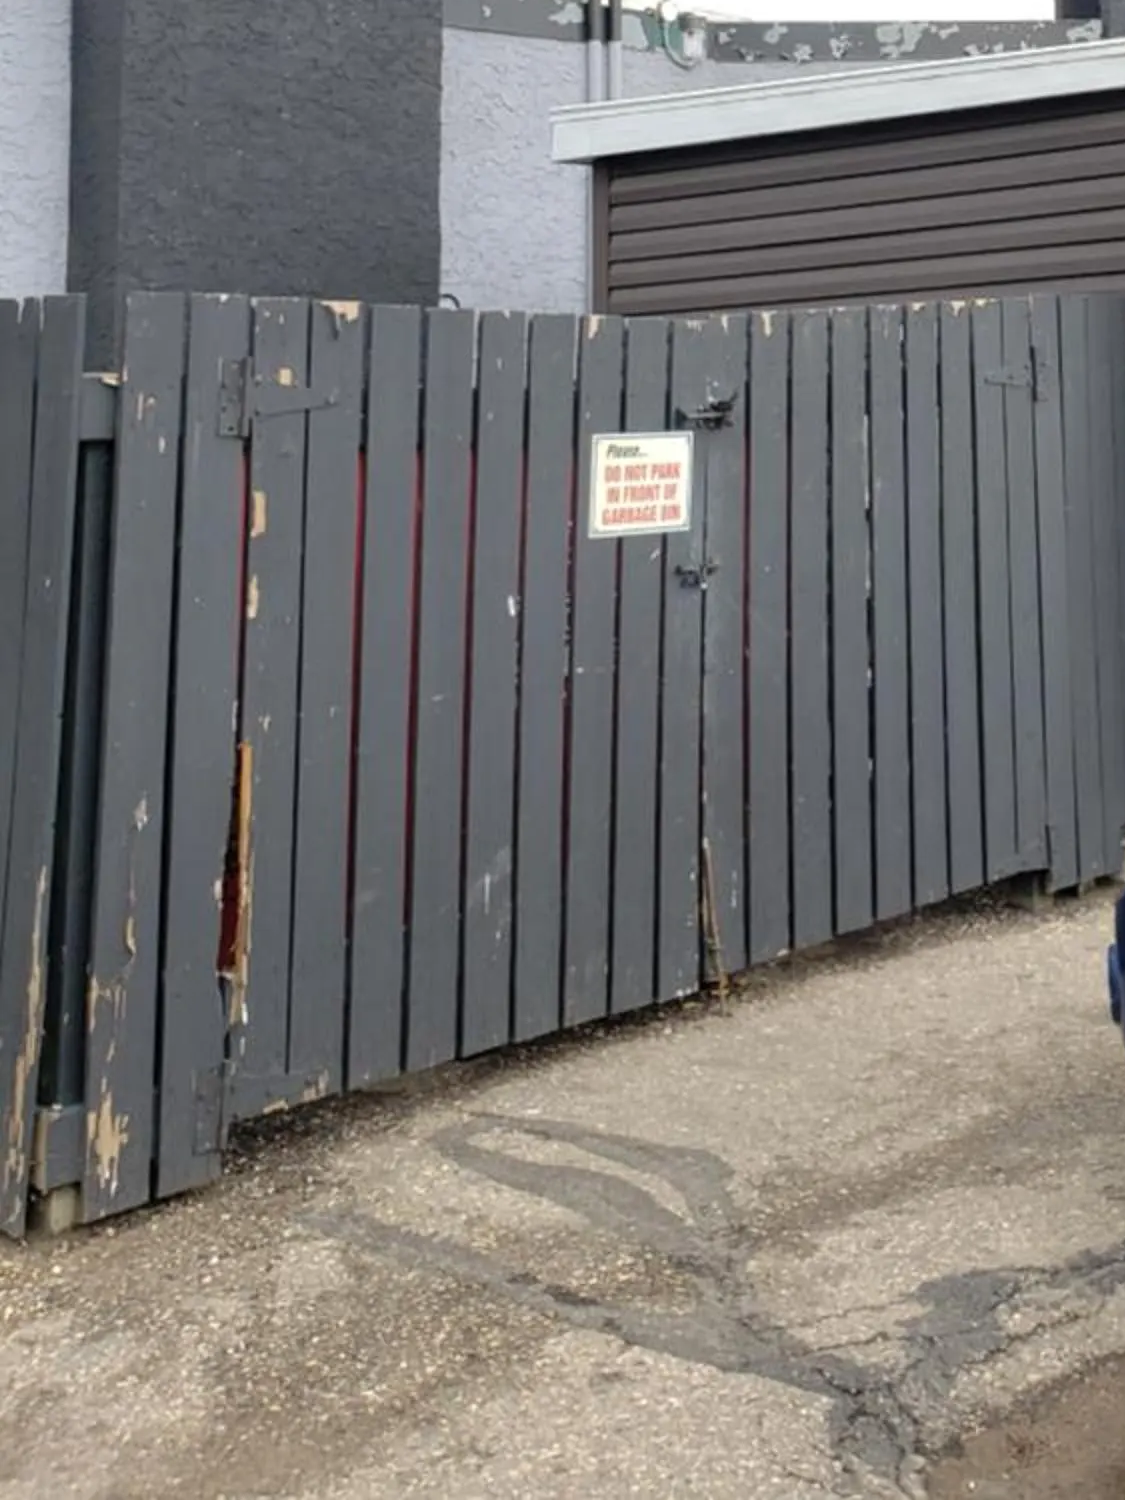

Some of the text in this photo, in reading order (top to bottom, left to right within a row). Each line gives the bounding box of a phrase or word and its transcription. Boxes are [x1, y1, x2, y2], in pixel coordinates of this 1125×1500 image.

[604, 462, 682, 482] DO NOT PARK
[606, 483, 678, 503] IN FRONT OF
[602, 503, 682, 525] GARBAGE BIN
